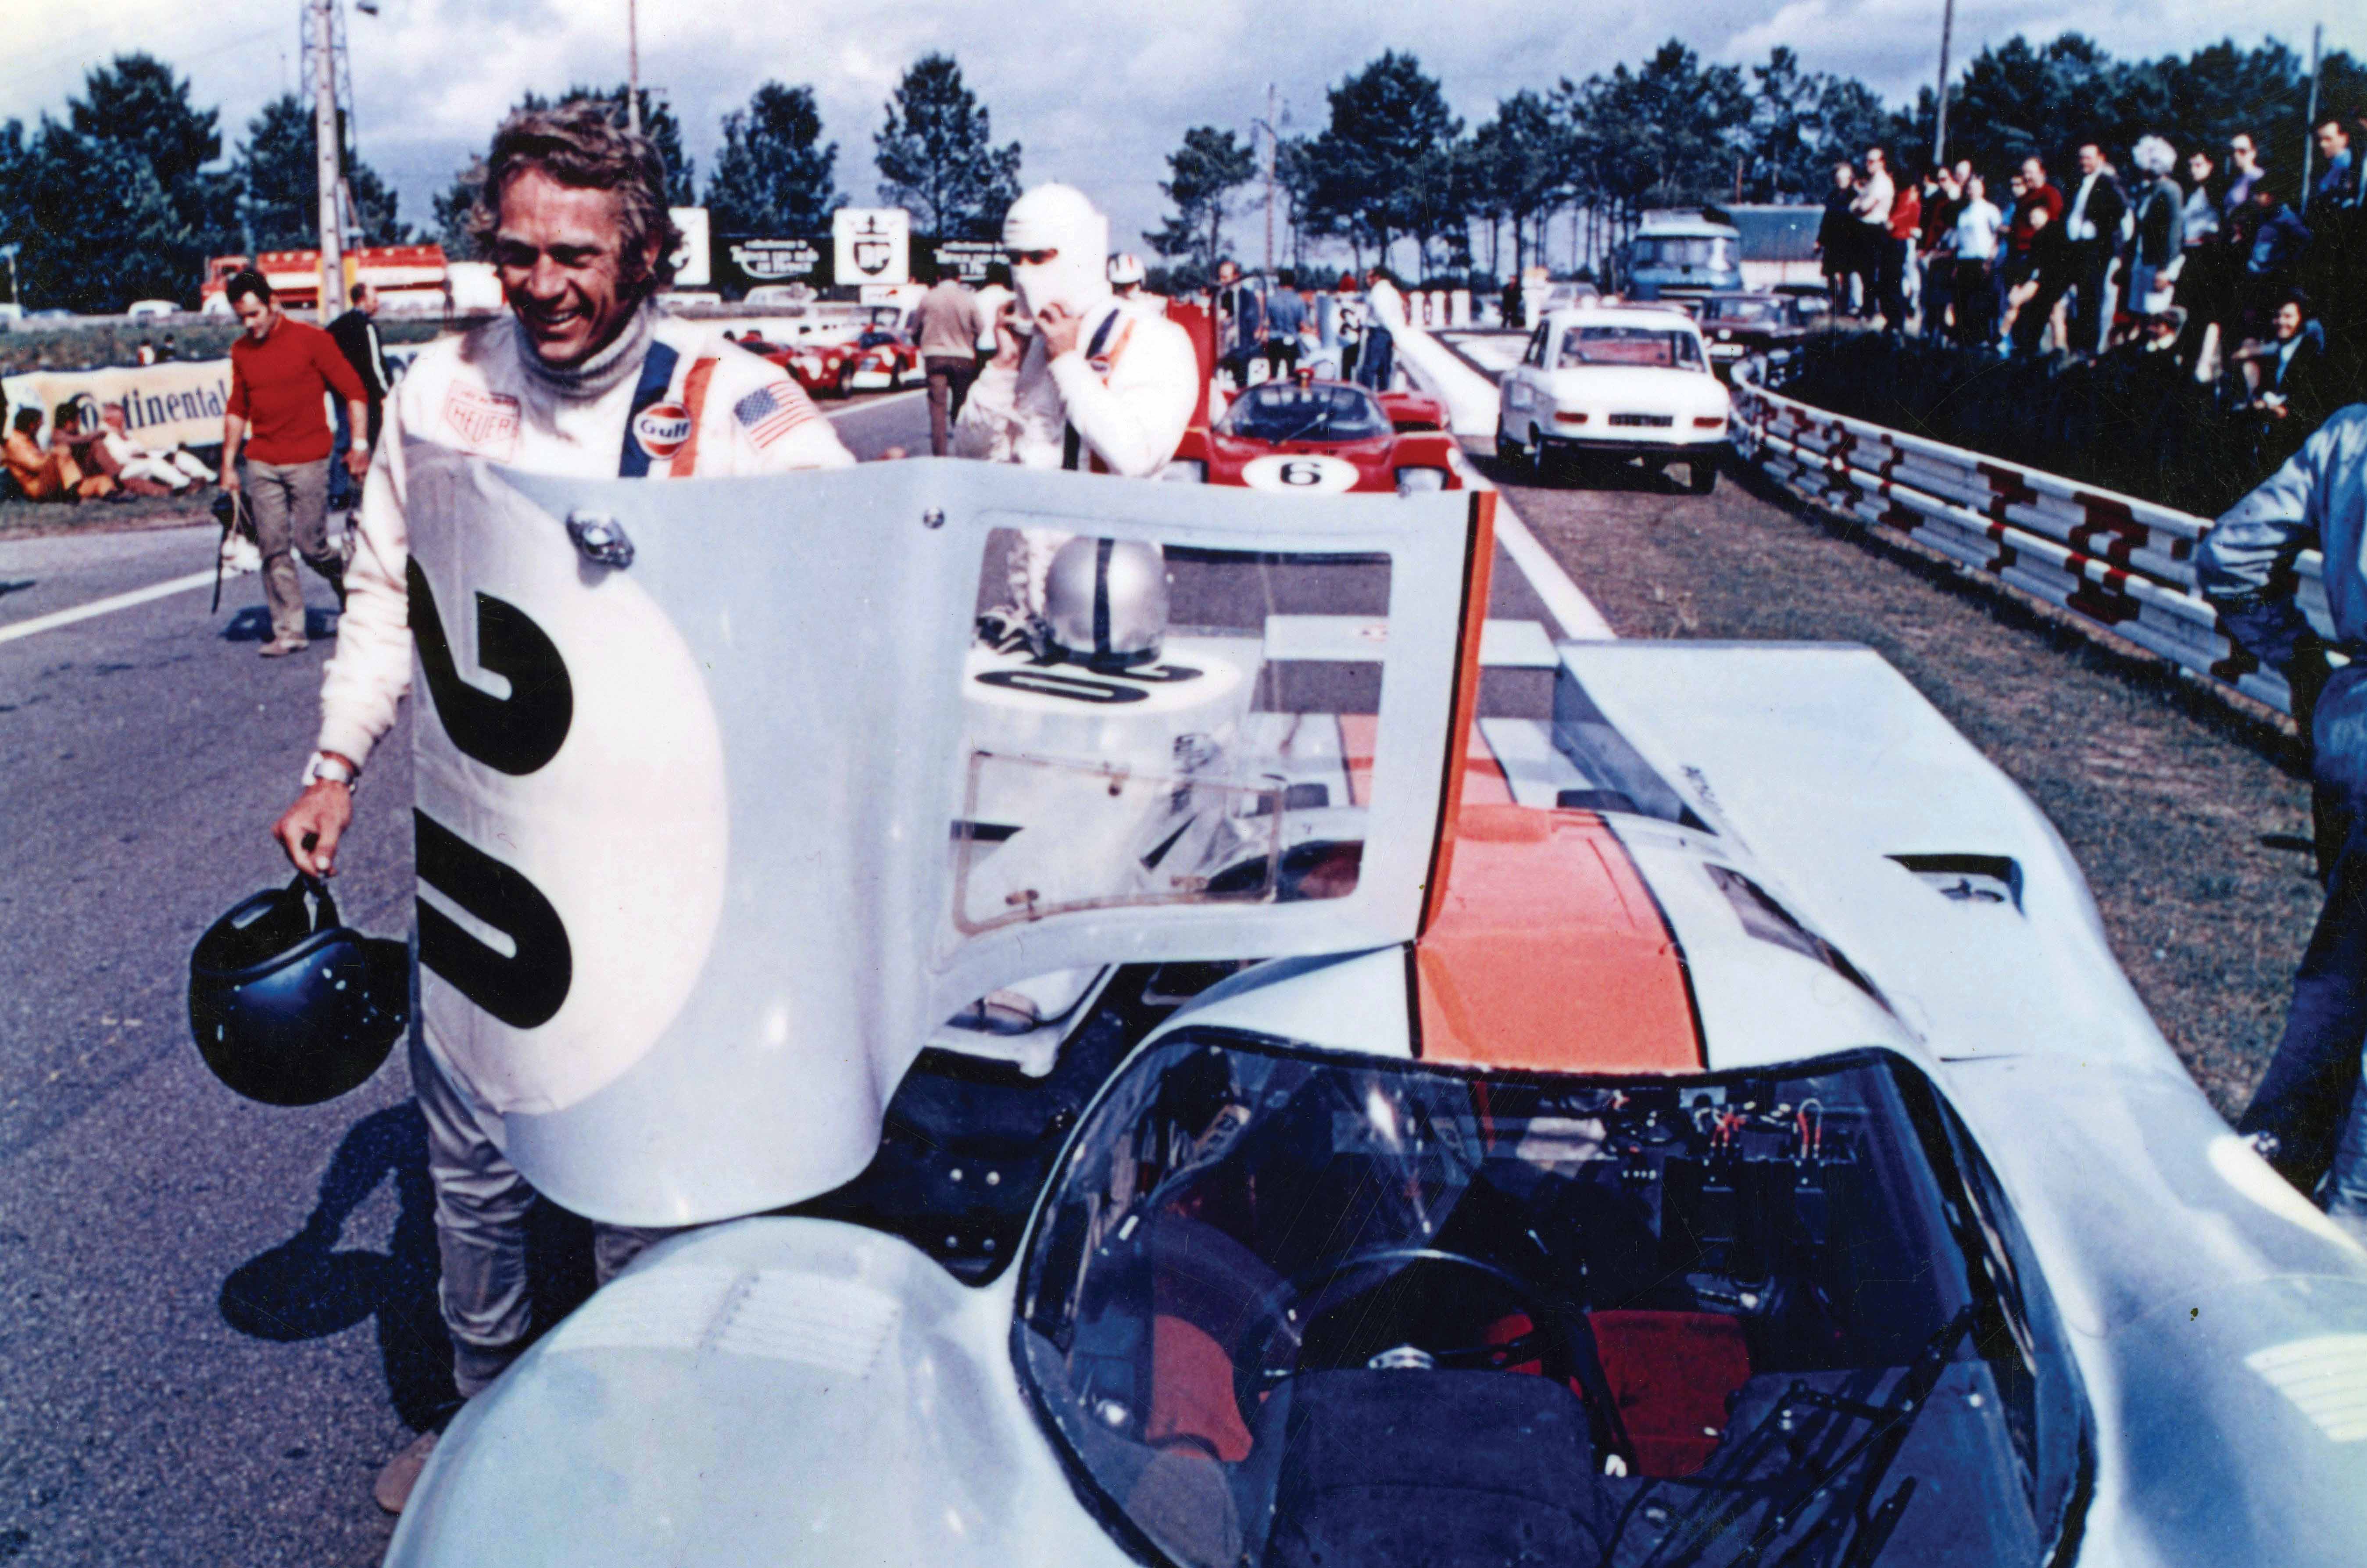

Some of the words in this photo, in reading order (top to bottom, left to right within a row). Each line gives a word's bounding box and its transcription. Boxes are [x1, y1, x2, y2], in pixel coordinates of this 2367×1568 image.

[640, 419, 689, 438] Gulf
[1280, 462, 1321, 486] 6
[406, 554, 574, 1029] 20
